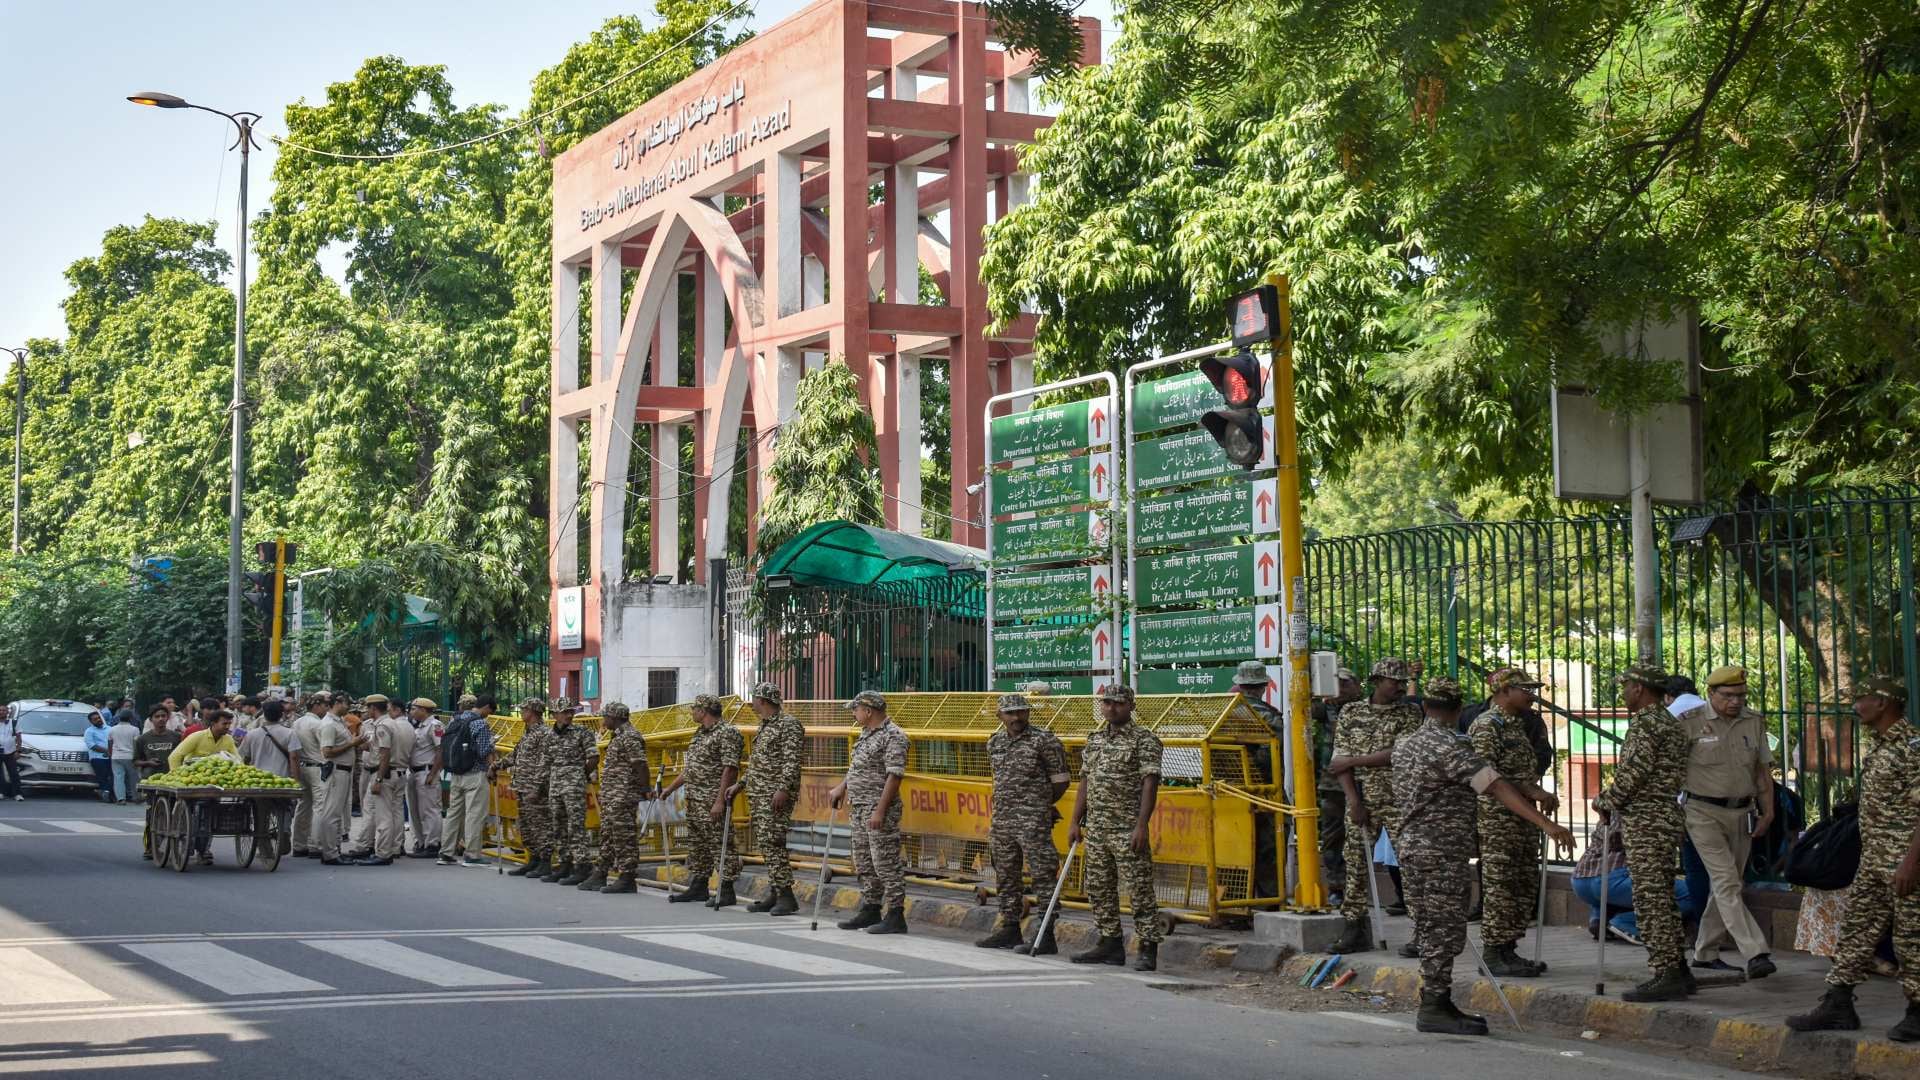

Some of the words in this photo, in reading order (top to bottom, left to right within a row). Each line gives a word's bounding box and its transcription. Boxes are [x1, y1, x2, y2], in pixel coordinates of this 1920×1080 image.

[581, 200, 616, 232] Bab-e
[617, 175, 667, 215] Maulana
[669, 147, 700, 188] Abul
[702, 129, 748, 171] Kalam
[749, 97, 792, 147] Azad
[1159, 411, 1188, 424] University
[1003, 446, 1033, 458] Department
[1034, 443, 1041, 453] of
[1042, 440, 1059, 451] Social
[1061, 436, 1077, 448] Work
[1138, 476, 1171, 488] Department
[1173, 471, 1179, 481] of
[1181, 463, 1224, 478] Environmental
[1000, 503, 1019, 513] Centre
[1019, 501, 1028, 510] for
[1029, 495, 1060, 508] Theoretical
[1137, 535, 1155, 544] Centre
[1155, 532, 1164, 541] for
[1166, 529, 1196, 541] Nanoscience
[1197, 525, 1208, 536] and
[1210, 521, 1251, 534] Nanotechnology
[1164, 591, 1183, 602] Zakir
[1185, 587, 1209, 599] Husain
[1211, 585, 1239, 597] Library
[586, 665, 593, 691] 7
[910, 787, 950, 813] DELHI
[957, 792, 993, 818] POLI
